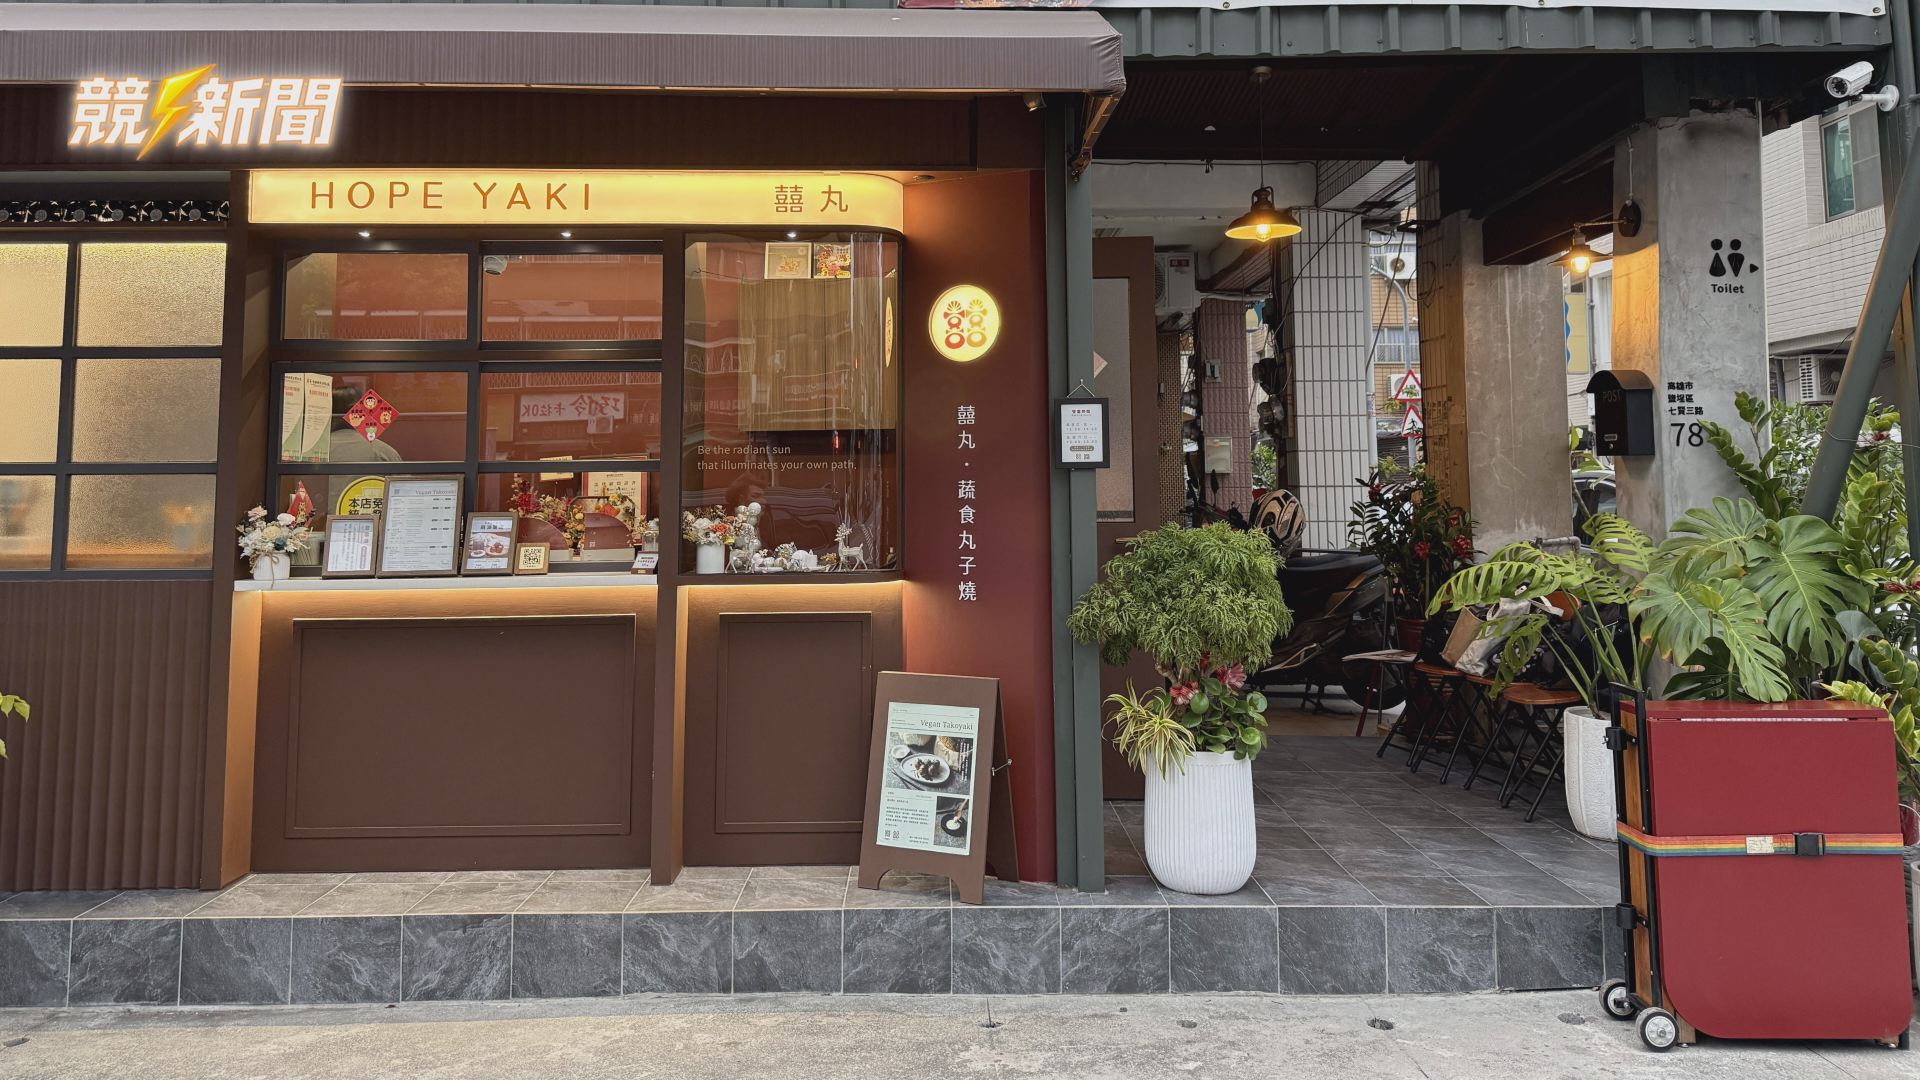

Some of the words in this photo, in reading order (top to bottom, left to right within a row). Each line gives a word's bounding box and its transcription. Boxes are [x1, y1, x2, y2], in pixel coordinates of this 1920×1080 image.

[311, 181, 443, 209] HOPE
[473, 182, 590, 211] YAKI
[773, 184, 849, 214] 囍丸
[1710, 283, 1745, 294] Toilet
[1667, 382, 1694, 391] 高雄市
[1667, 394, 1694, 403] 鹽埕區
[1667, 406, 1704, 416] 七賢三路
[1670, 422, 1704, 447] 78
[697, 445, 710, 455] Be
[713, 445, 730, 455] the
[733, 444, 770, 455] radiant
[772, 446, 791, 454] sun
[697, 460, 718, 470] that
[721, 460, 778, 470] illuminates
[780, 461, 803, 472] your
[806, 461, 828, 469] own
[920, 719, 941, 729] Vegan
[942, 721, 973, 731] Takoyaki
